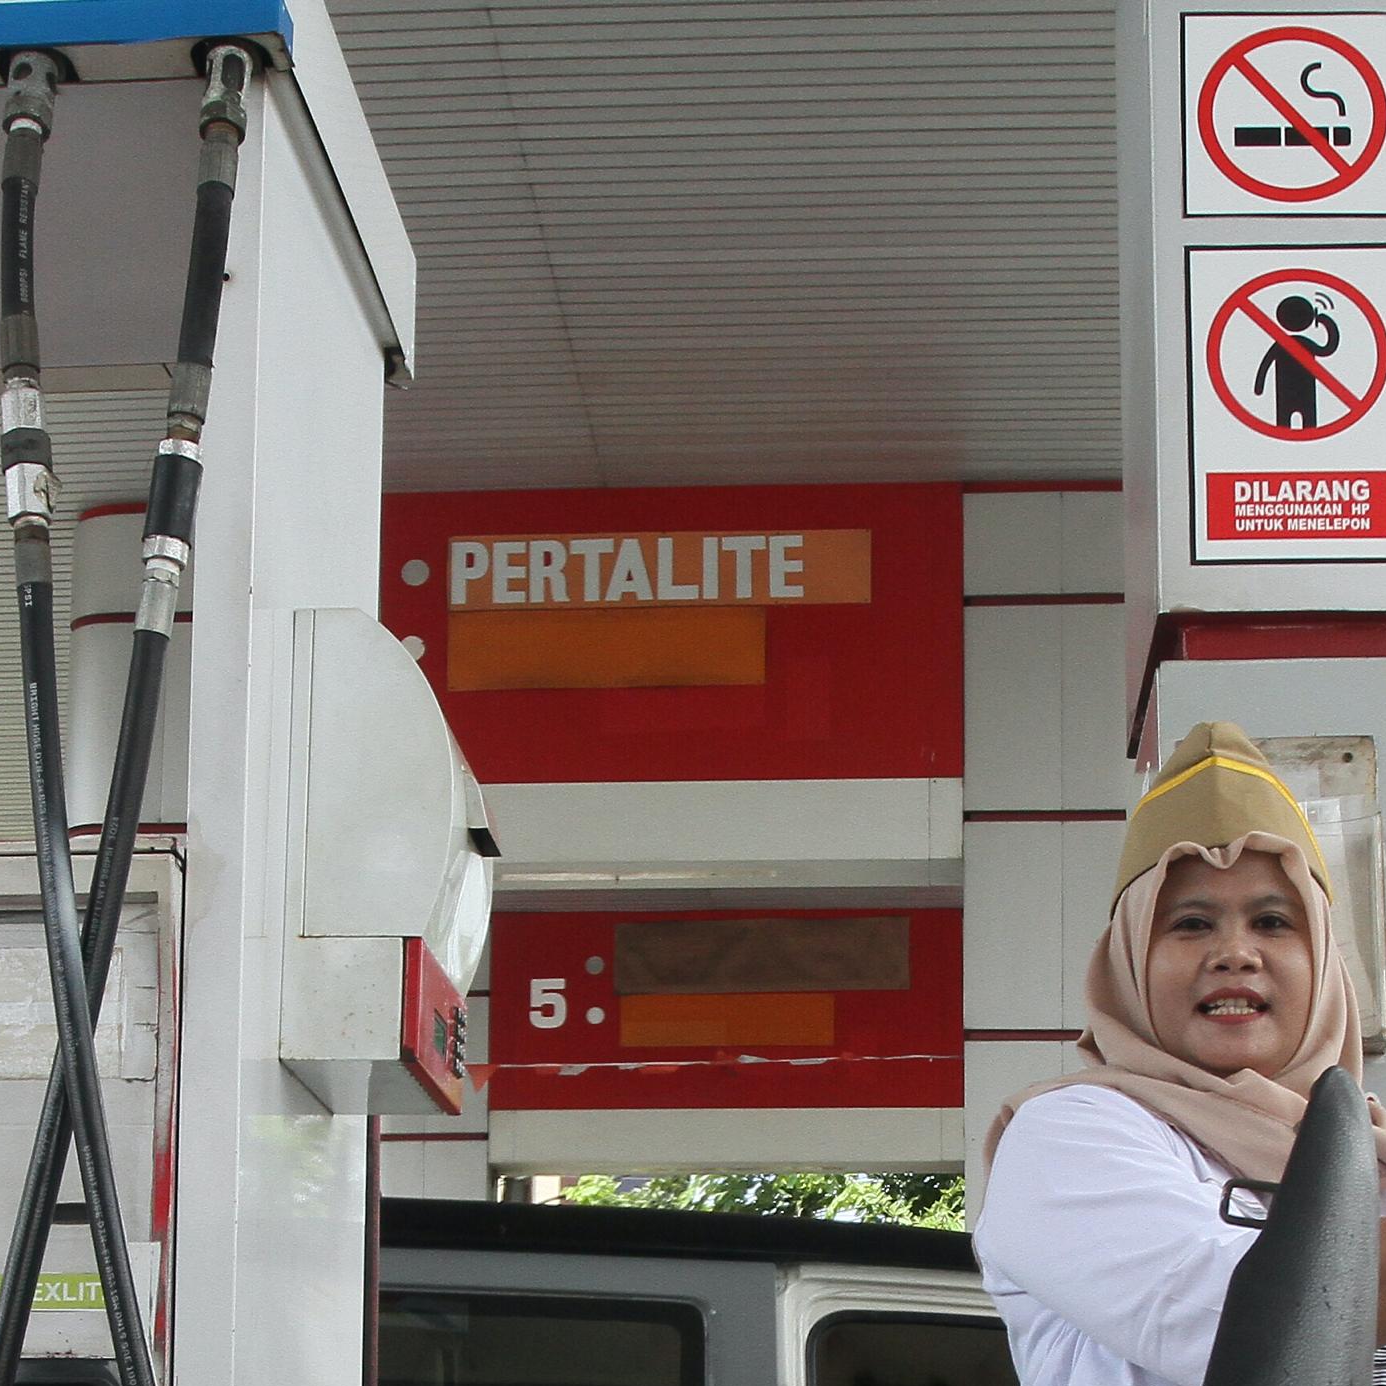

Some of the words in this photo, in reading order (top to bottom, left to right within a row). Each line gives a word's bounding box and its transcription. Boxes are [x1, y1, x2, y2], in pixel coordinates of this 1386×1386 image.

[1234, 480, 1370, 503] DILARANG
[1235, 504, 1342, 516] MENGGUNAKAN
[1351, 503, 1370, 515] HP
[1235, 519, 1284, 531] UNTUK
[1287, 518, 1370, 530] MENELEPON
[449, 534, 804, 605] PERTALITE
[528, 977, 568, 1028] 5
